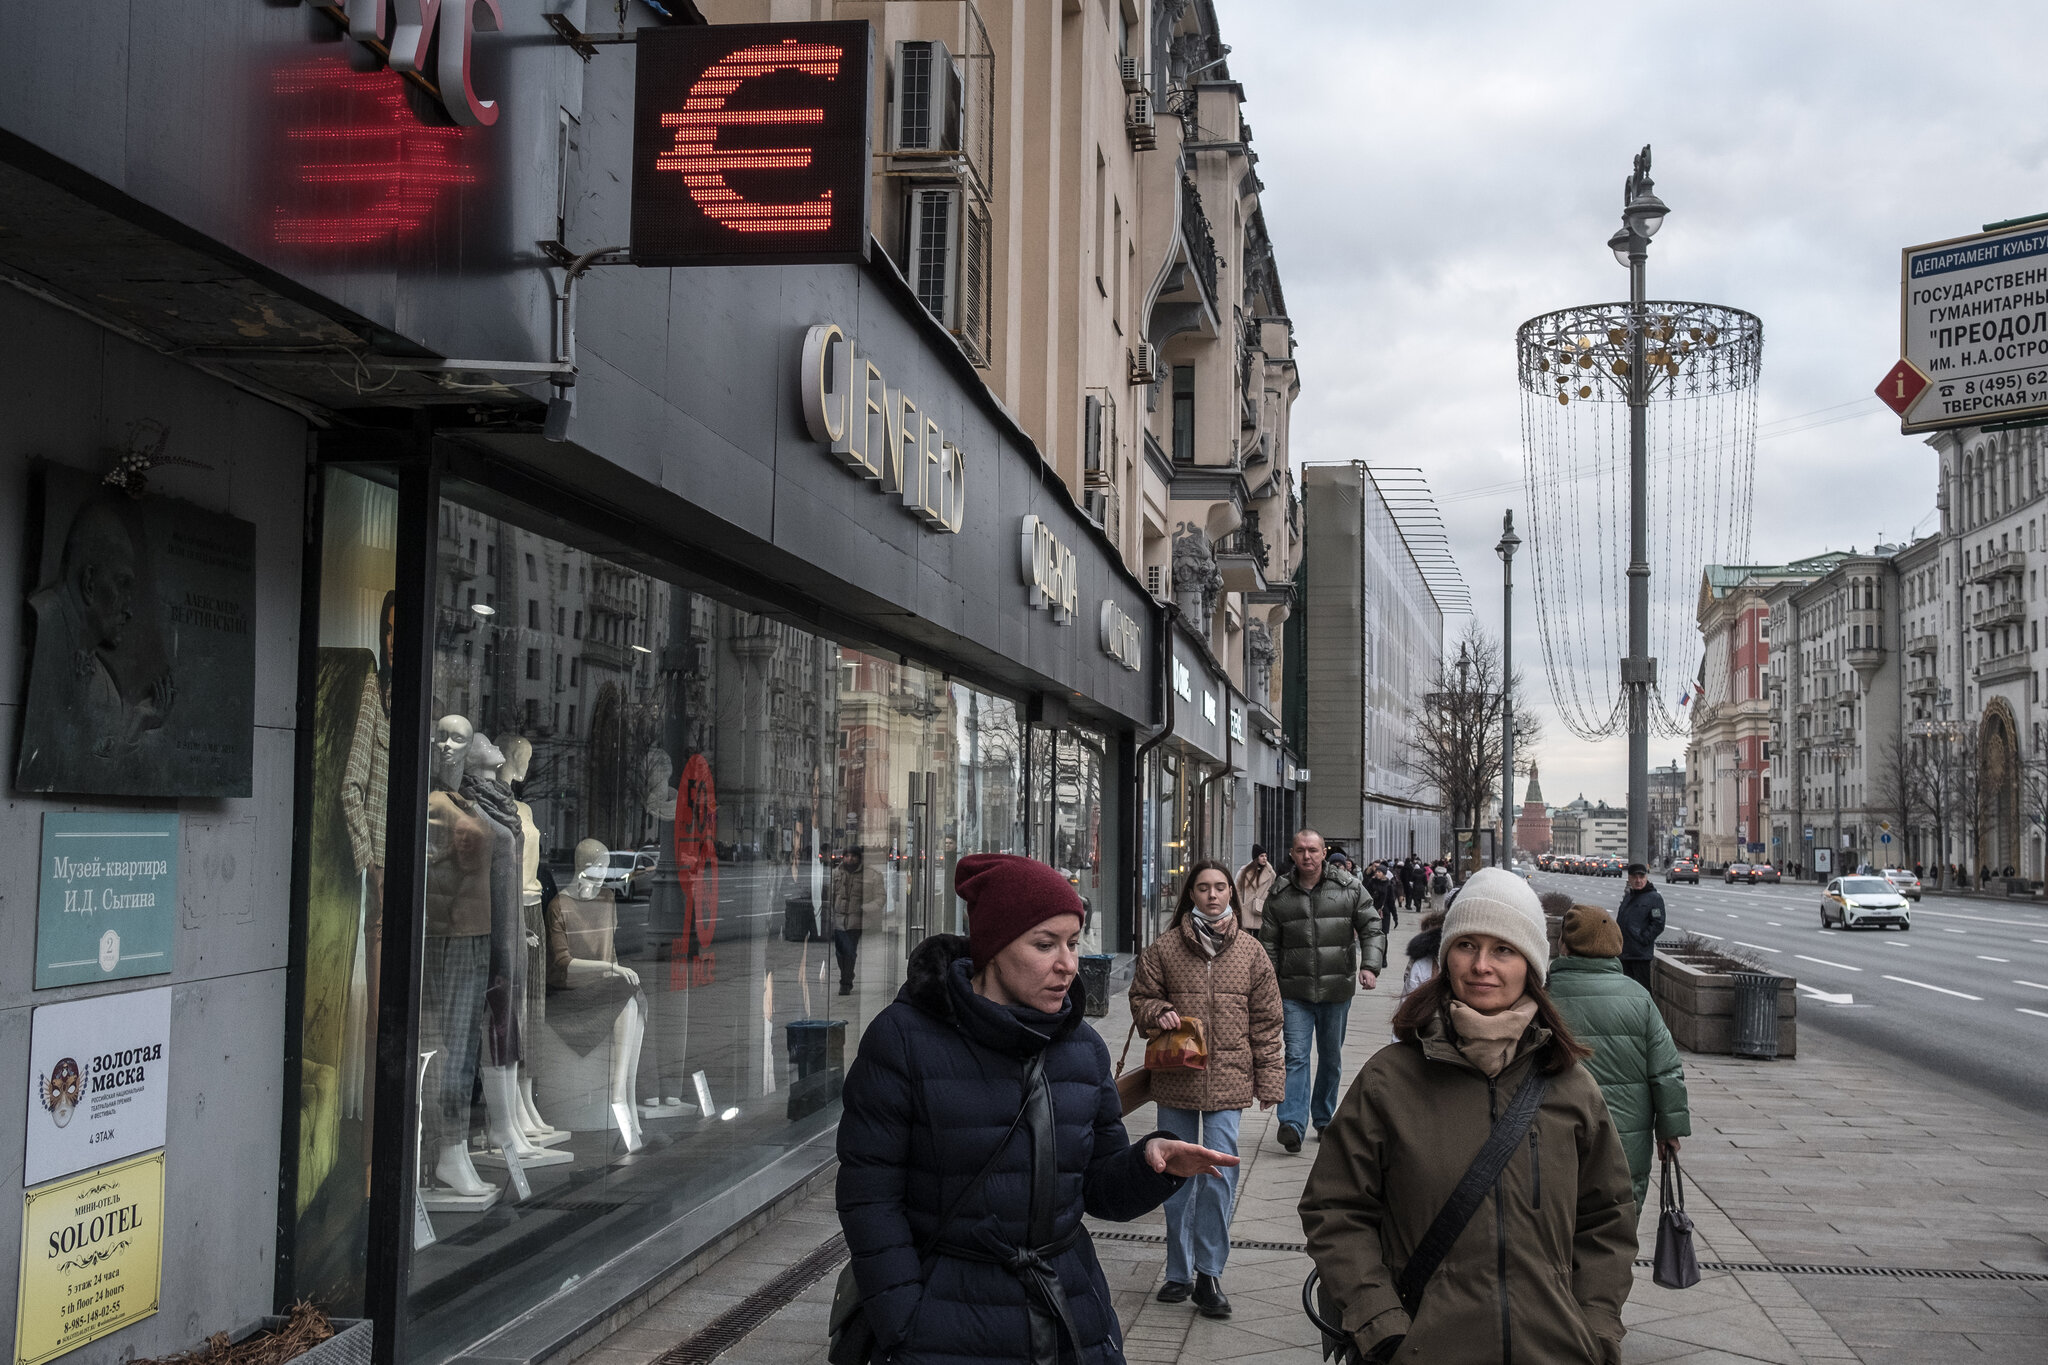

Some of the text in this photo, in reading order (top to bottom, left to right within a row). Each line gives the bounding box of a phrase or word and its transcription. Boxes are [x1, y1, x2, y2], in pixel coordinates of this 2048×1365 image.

[1915, 234, 2048, 276] ДЕПАРТАМЕНТ КУЛЬТУ
[1930, 311, 2047, 348] "ПРЕОДОЛ
[1930, 357, 1956, 372] ИМ.
[1965, 370, 2048, 395] 8 (495) 62
[1943, 391, 2027, 414] ТВЕРСКАЯ
[1022, 514, 1078, 626] ОДЕЖДА
[53, 856, 168, 884] Музей-квартира
[64, 888, 156, 917] И.Д. Сытина
[106, 937, 114, 954] 2
[95, 1128, 116, 1144] ЭТАЖ
[74, 1194, 121, 1217] МИНИ-ОТЕЛЬ
[48, 1203, 143, 1260] SOLOTEL
[67, 1267, 120, 1297] 5 этаж 24 часа
[60, 1283, 125, 1318] 5 th floor 24 hours
[63, 1300, 121, 1334] 8-985-148-02-55
